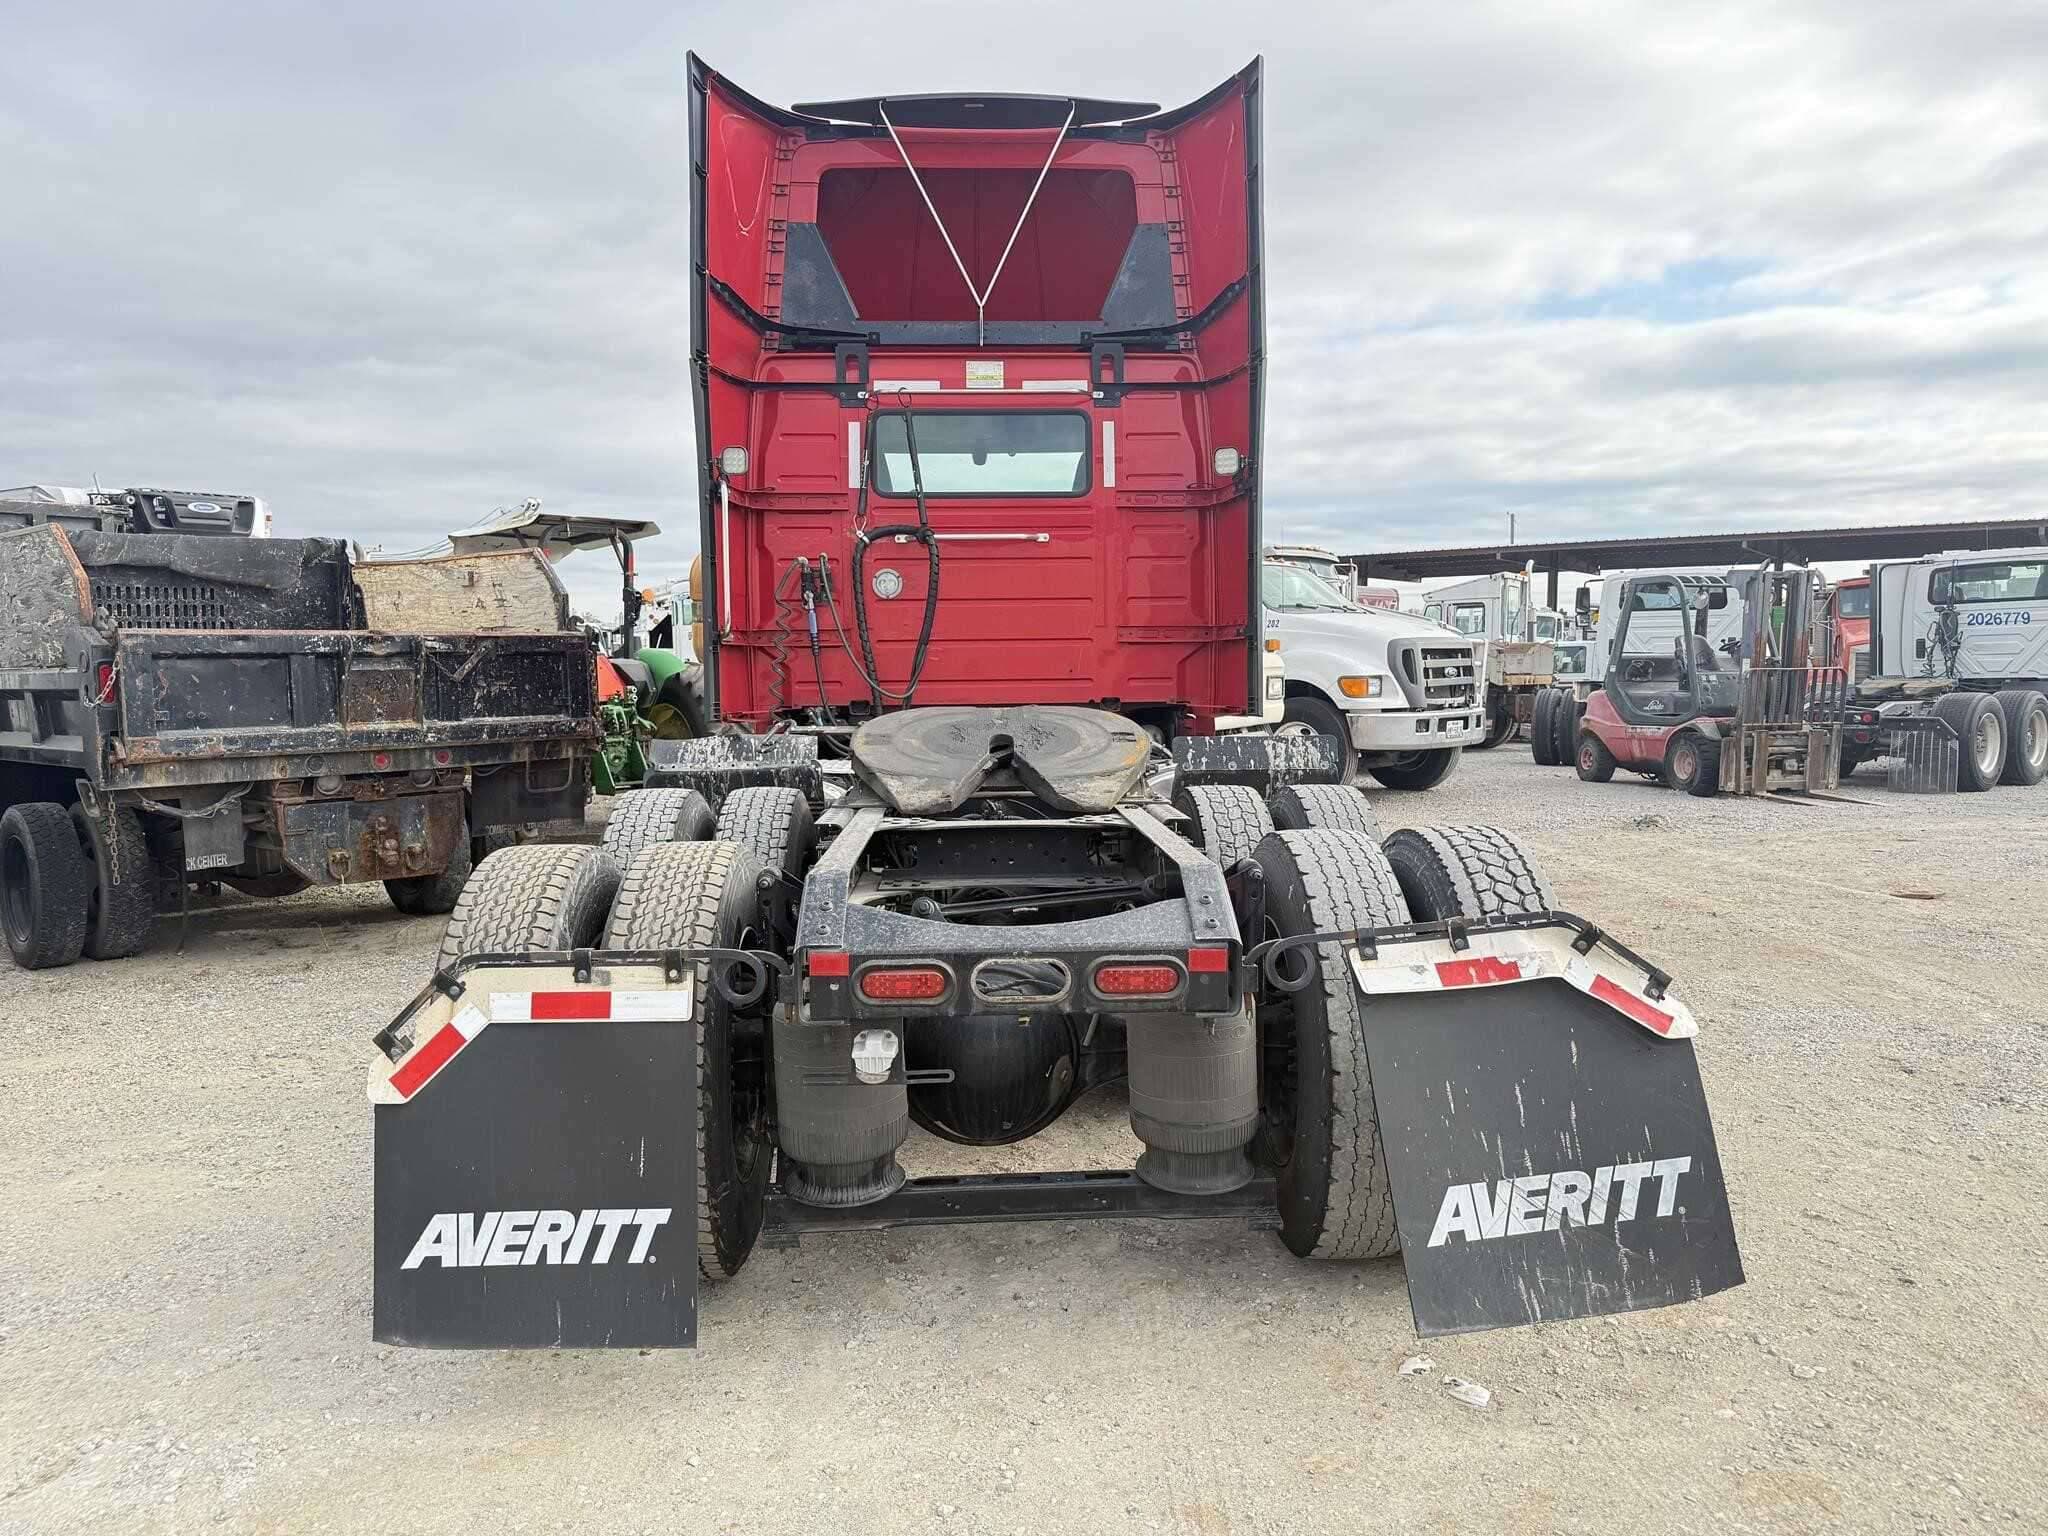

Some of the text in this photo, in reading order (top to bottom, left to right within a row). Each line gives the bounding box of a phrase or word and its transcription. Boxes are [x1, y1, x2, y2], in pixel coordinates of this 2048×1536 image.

[1967, 611, 2031, 626] 2026779
[197, 853, 228, 868] CENTER
[1426, 1156, 1692, 1248] AVERITT
[400, 1208, 672, 1270] AVERITT
